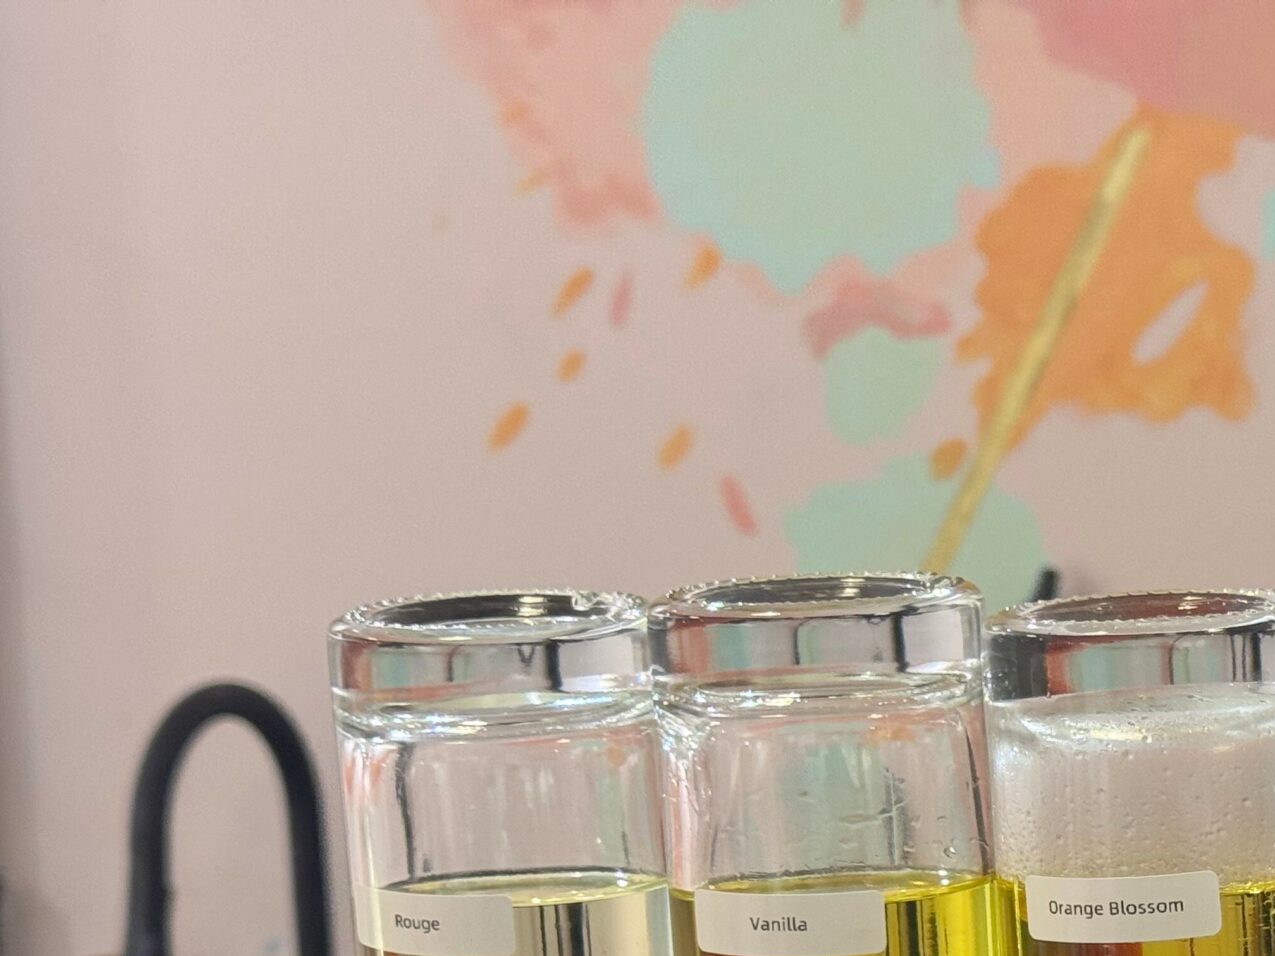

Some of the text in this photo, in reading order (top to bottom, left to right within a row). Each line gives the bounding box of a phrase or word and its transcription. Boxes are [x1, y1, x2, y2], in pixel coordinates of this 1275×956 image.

[1049, 899, 1184, 919] Orange Blossom
[394, 914, 441, 934] Rouge
[749, 916, 808, 932] Vanilla
